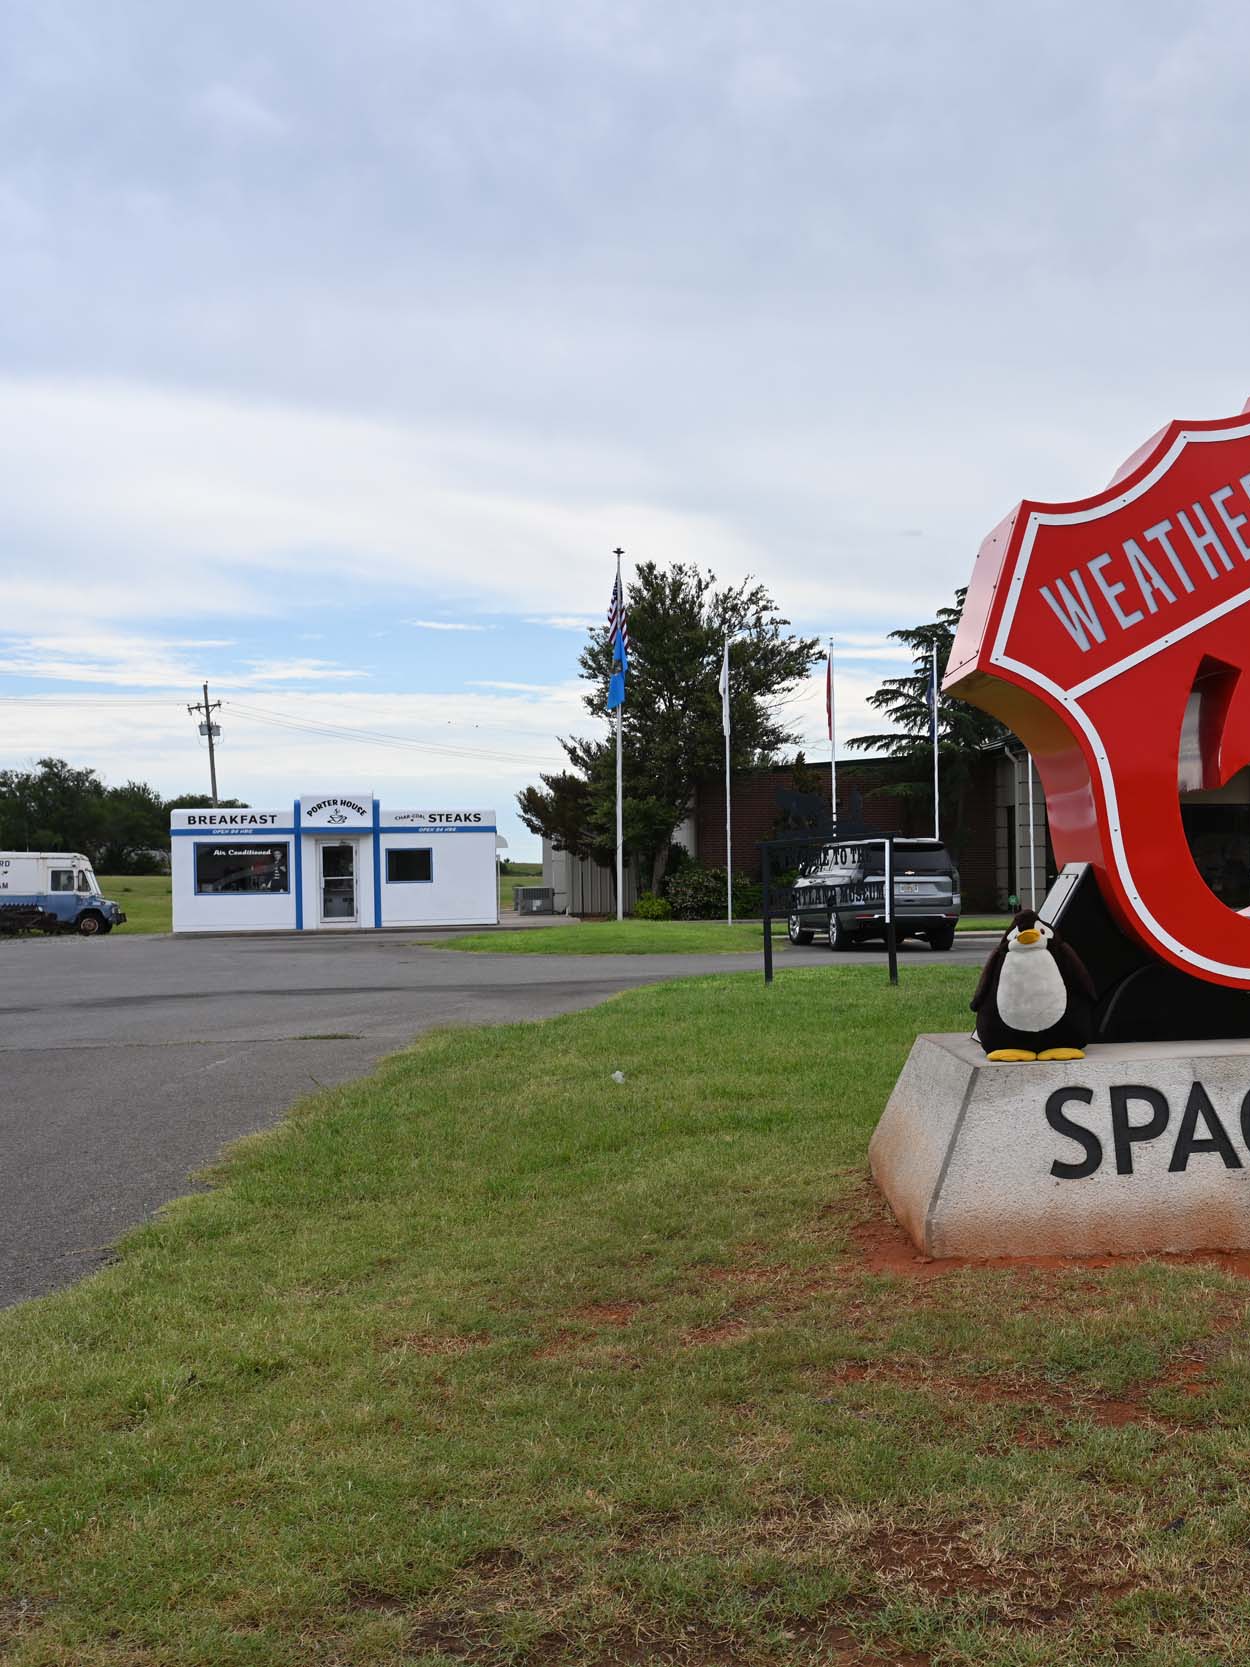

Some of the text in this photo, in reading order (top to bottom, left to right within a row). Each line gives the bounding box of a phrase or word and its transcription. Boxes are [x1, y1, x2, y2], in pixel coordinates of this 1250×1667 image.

[306, 799, 367, 817] PORTER HOUSE
[187, 814, 277, 825] BREAKFAST
[428, 813, 482, 823] STEAKS
